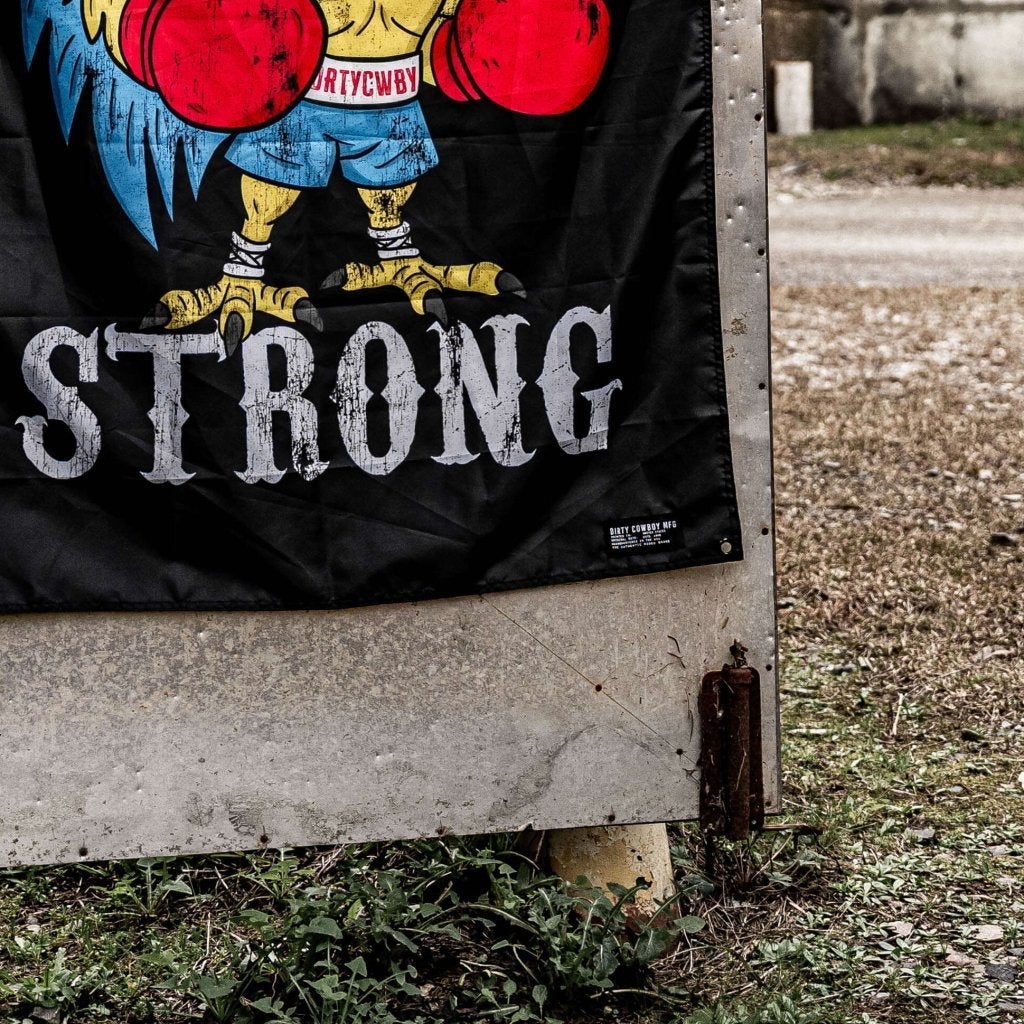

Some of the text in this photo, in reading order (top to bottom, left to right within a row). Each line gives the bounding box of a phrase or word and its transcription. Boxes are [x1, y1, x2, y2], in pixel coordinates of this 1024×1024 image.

[15, 304, 622, 485] STRONG
[609, 520, 677, 536] DIRTY COWBOY MFG
